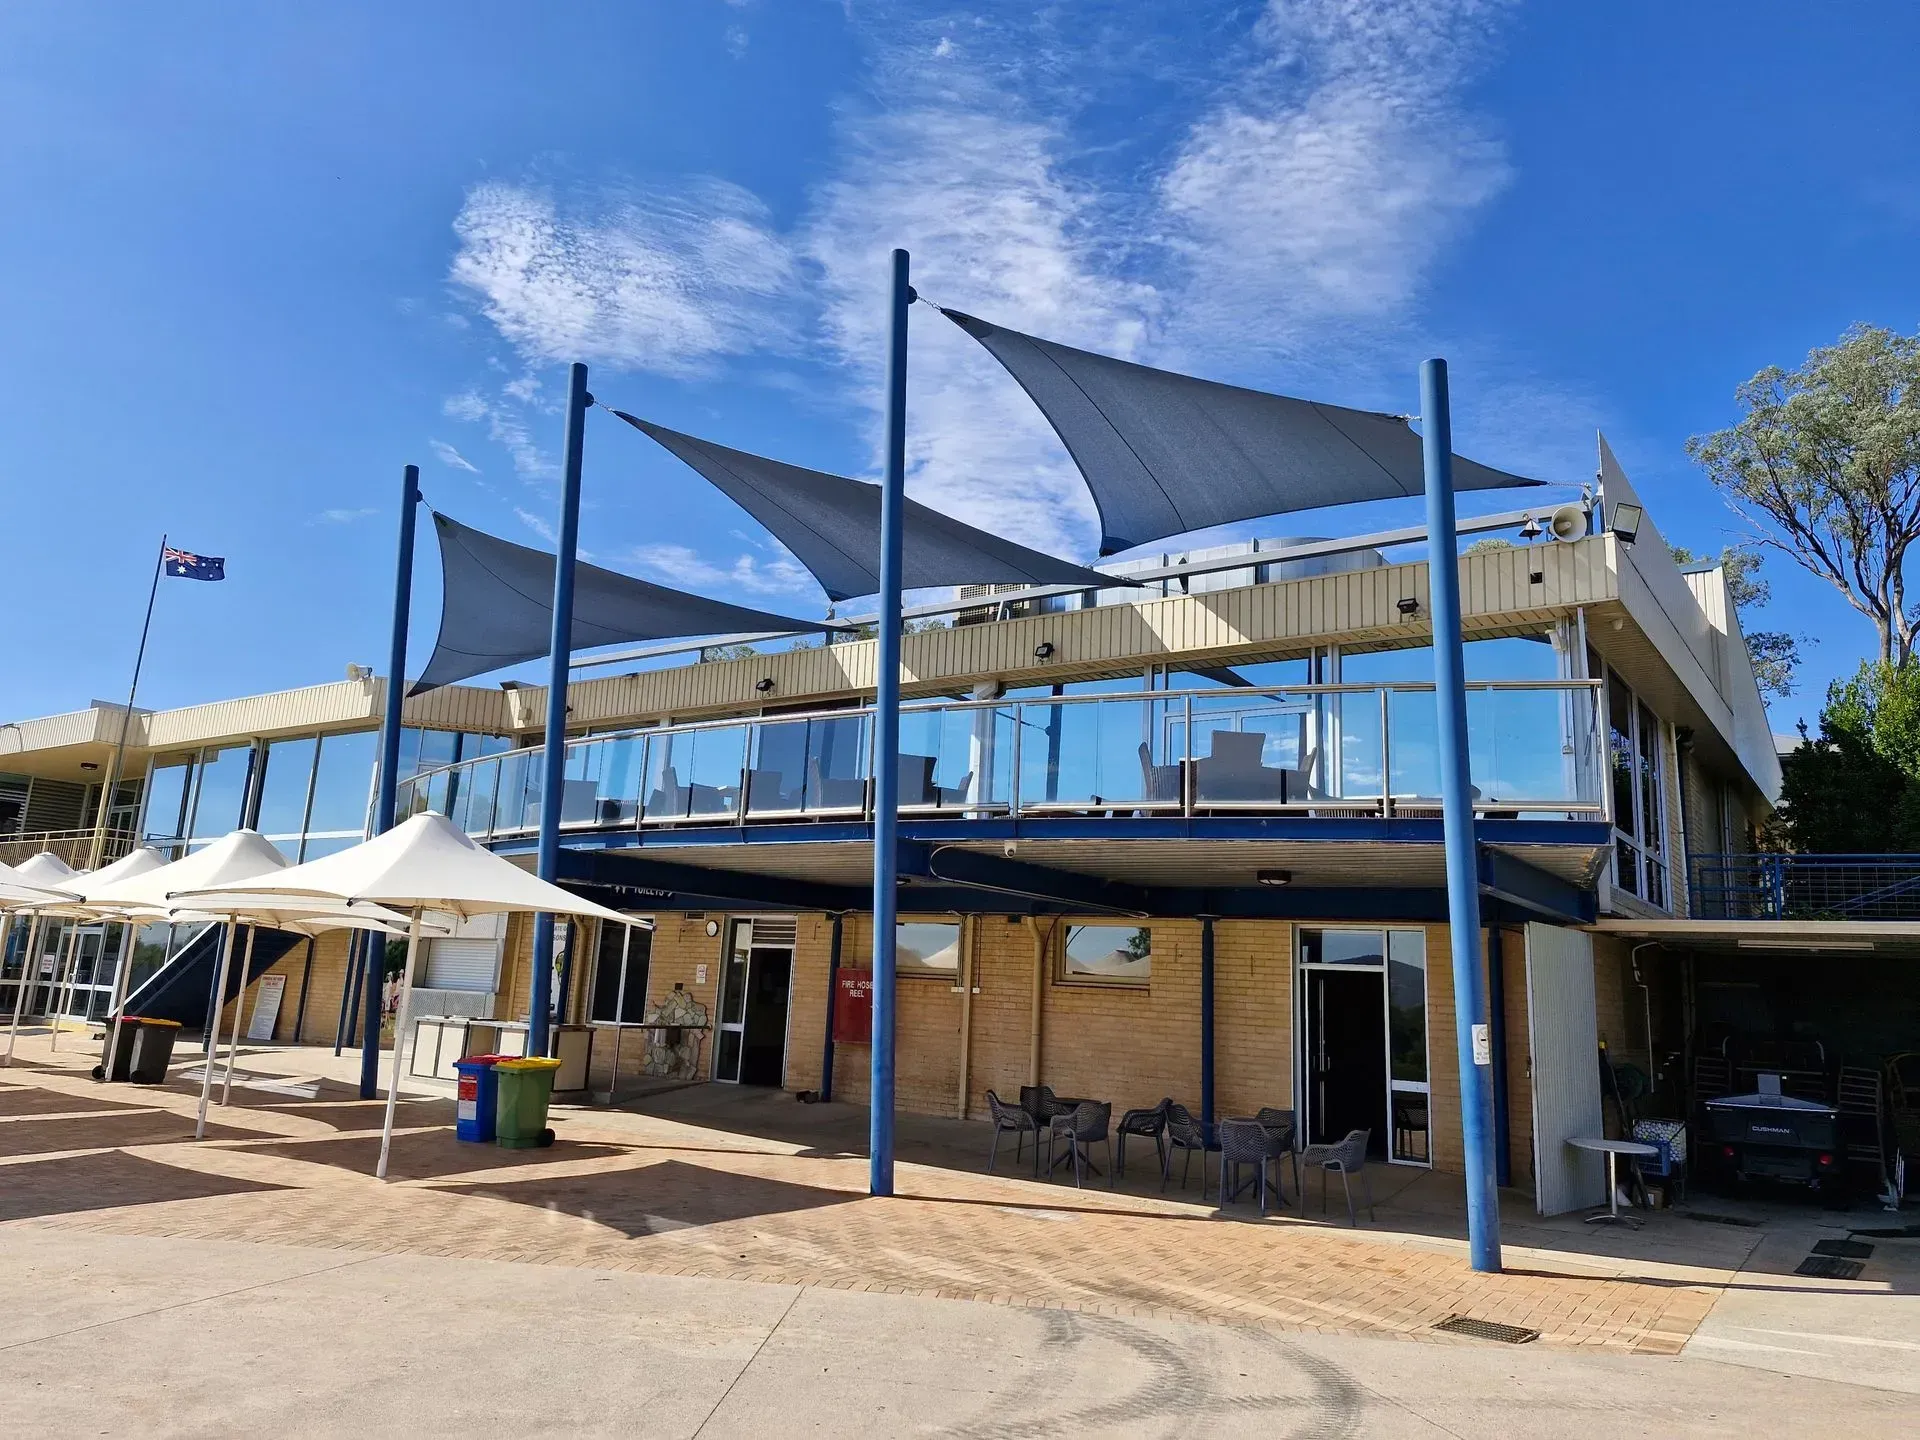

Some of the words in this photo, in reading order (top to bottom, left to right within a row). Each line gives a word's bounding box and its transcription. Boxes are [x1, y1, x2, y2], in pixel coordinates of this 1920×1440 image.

[842, 980, 855, 988] FIRE
[849, 989, 864, 998] REEL
[1752, 1125, 1790, 1134] CUSHMAN
